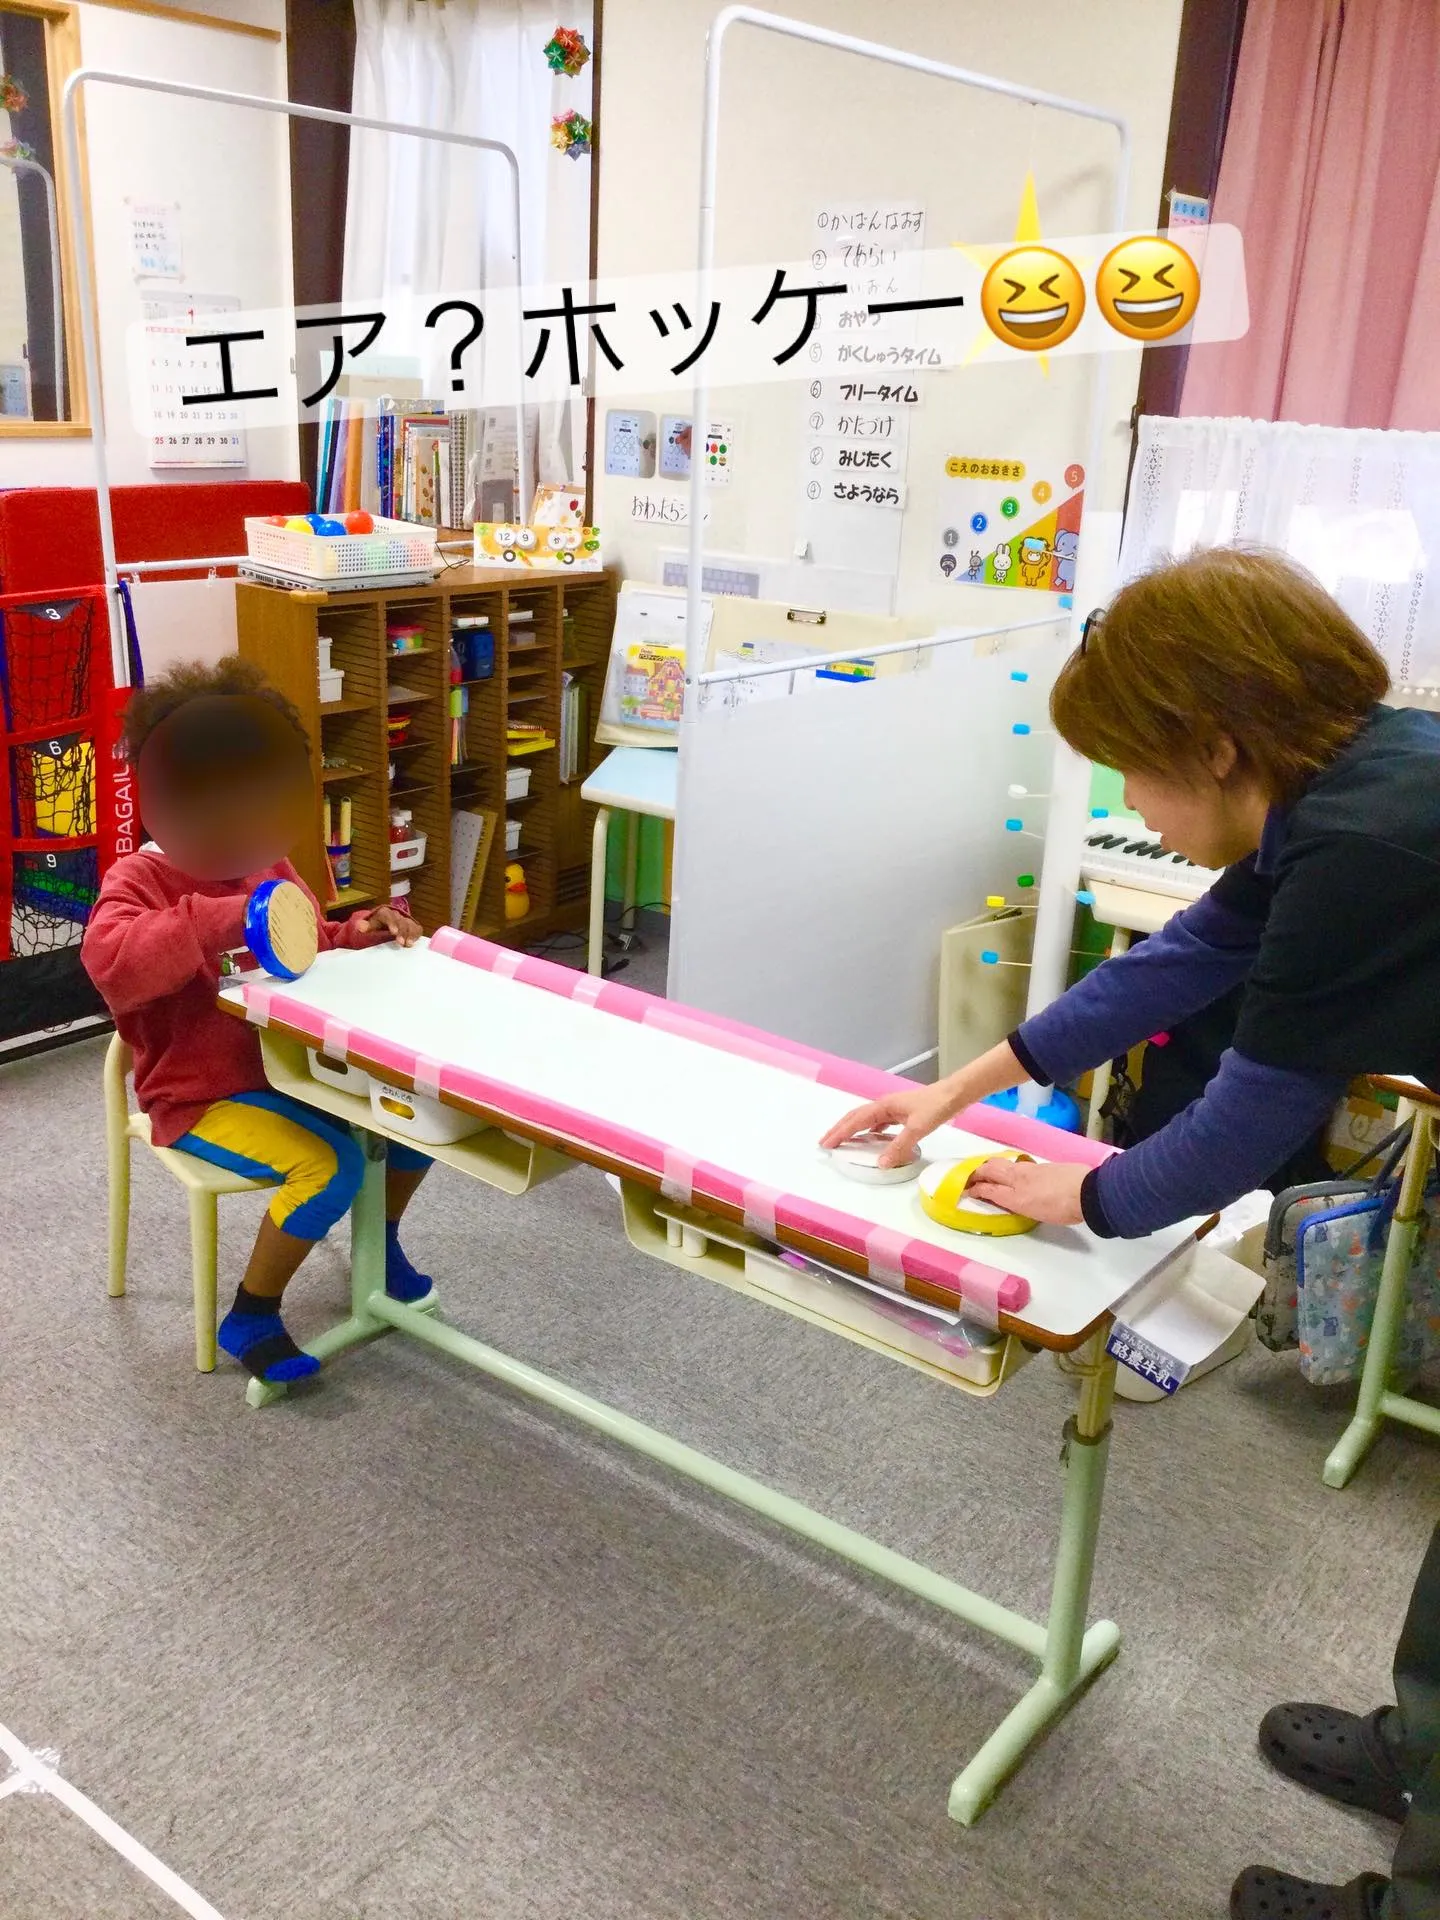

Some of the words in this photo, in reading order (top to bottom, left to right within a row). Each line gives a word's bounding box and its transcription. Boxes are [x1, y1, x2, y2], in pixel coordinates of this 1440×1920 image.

[837, 344, 942, 365] がくしゅうタイム
[839, 383, 919, 403] フリータイム
[837, 415, 895, 437] かたづけ
[154, 437, 164, 446] 25
[168, 437, 177, 446] 26
[181, 437, 190, 446] 27
[194, 437, 203, 446] 28
[207, 437, 216, 446] 29
[219, 437, 228, 446] 30
[838, 450, 892, 468] みじたく
[949, 461, 1021, 477] こえのおおきさ
[833, 482, 900, 505] さようなら
[498, 532, 511, 541] 12
[45, 608, 61, 620] 3
[49, 741, 62, 756] 6
[46, 854, 58, 869] 9
[1110, 1338, 1172, 1390] 酪農牛乳
